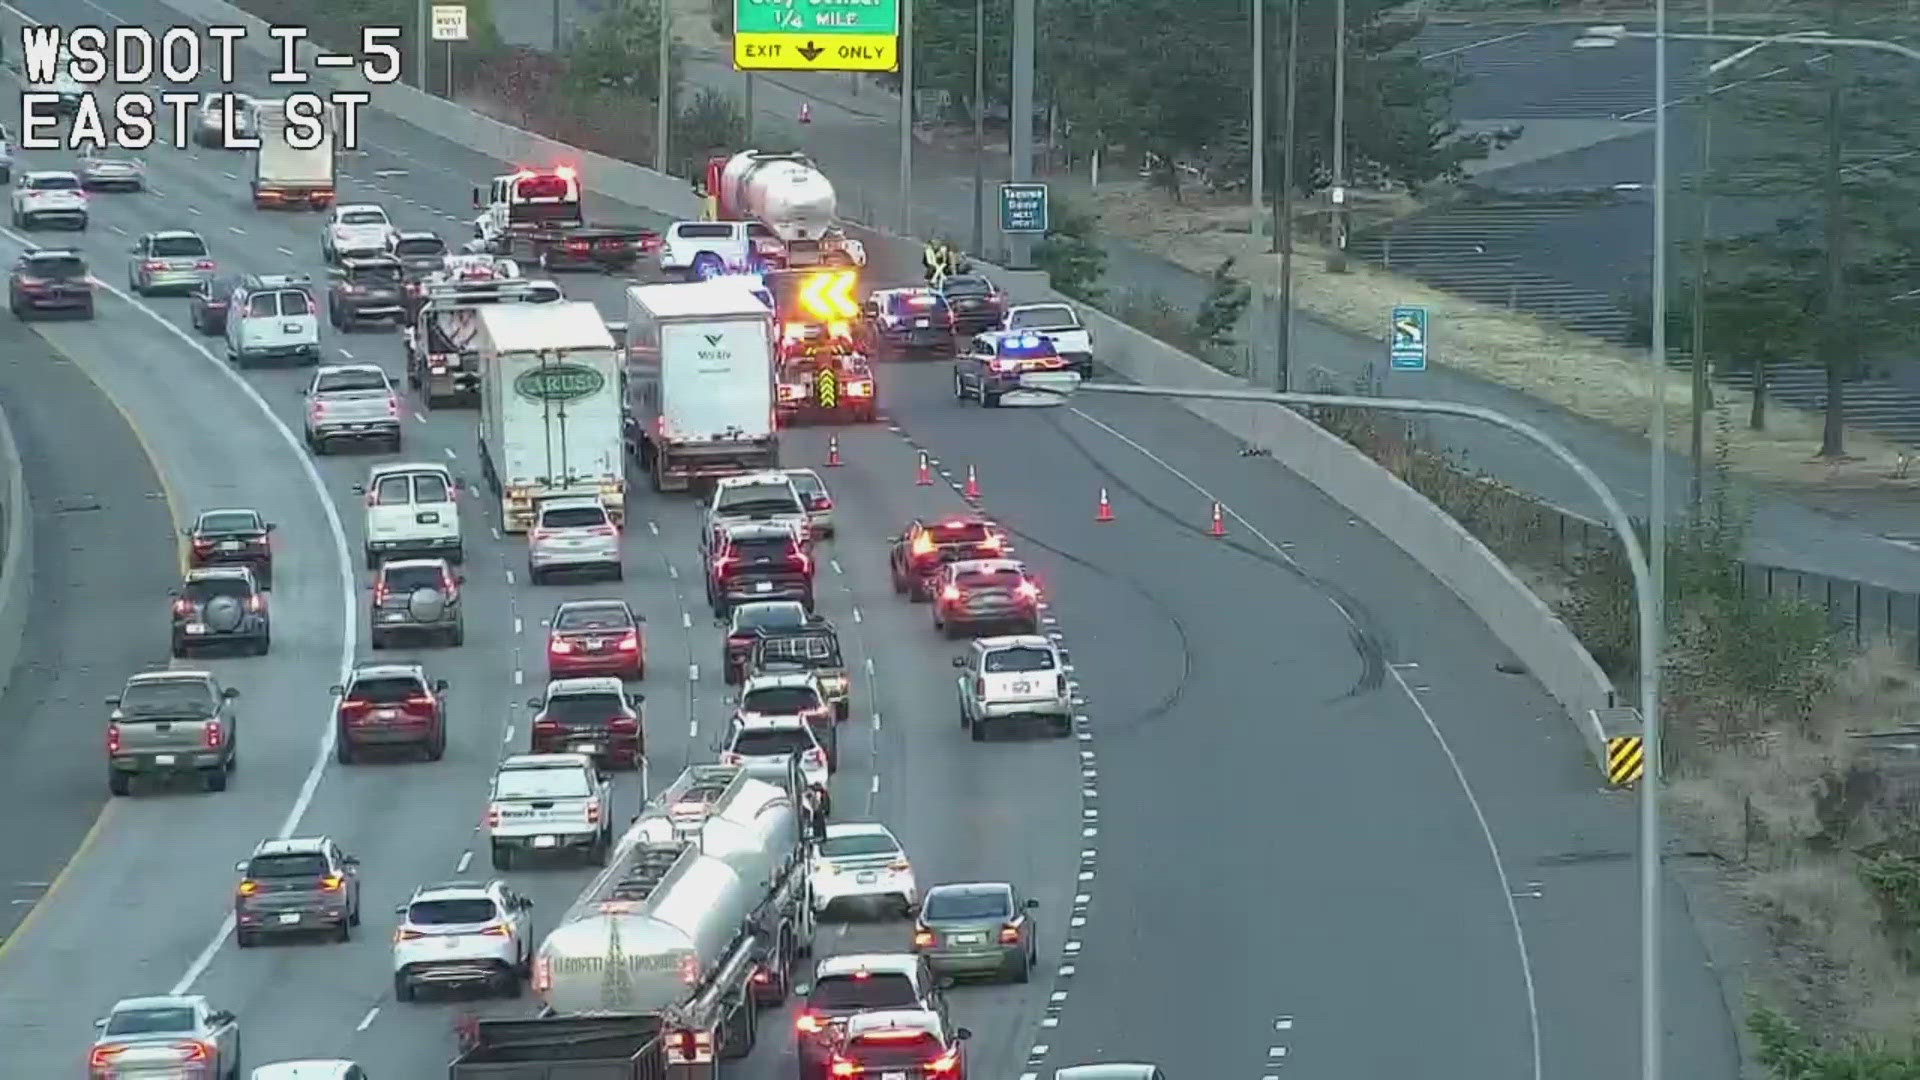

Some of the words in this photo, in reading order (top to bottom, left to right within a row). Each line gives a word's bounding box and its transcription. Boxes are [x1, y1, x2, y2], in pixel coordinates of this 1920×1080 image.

[815, 11, 859, 26] MILE
[745, 44, 782, 58] EXIT
[837, 46, 885, 59] ONLY
